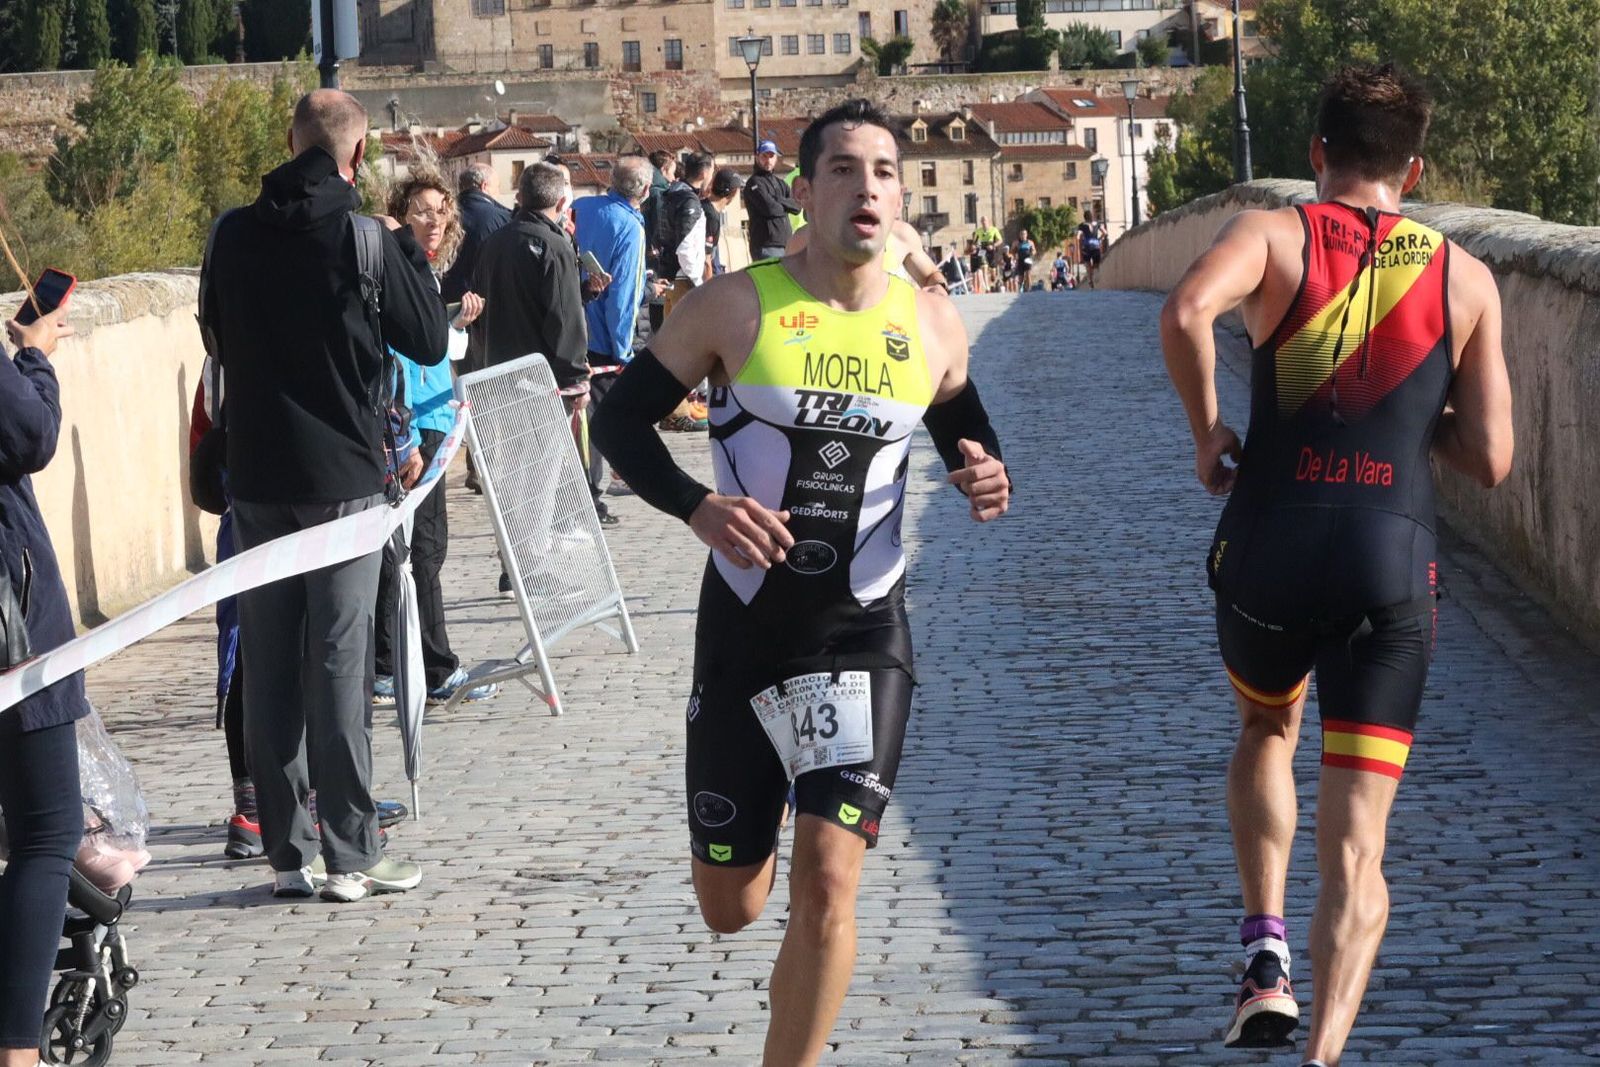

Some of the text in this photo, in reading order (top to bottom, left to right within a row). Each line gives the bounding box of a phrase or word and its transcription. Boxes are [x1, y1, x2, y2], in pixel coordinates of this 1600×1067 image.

[1374, 256, 1387, 269] DE
[1389, 254, 1400, 267] LA
[1402, 252, 1432, 267] ORDEN
[803, 352, 894, 397] MORLA
[795, 389, 854, 412] TRI
[1296, 447, 1393, 487] De La Vara
[813, 471, 844, 483] GRUPO
[796, 480, 855, 494] FISIOCLINICAS
[790, 505, 849, 520] GEDSPORTS
[770, 673, 866, 695] FDERACIO DE
[833, 688, 866, 696] LEON
[840, 770, 891, 798] GEDSPORTS
